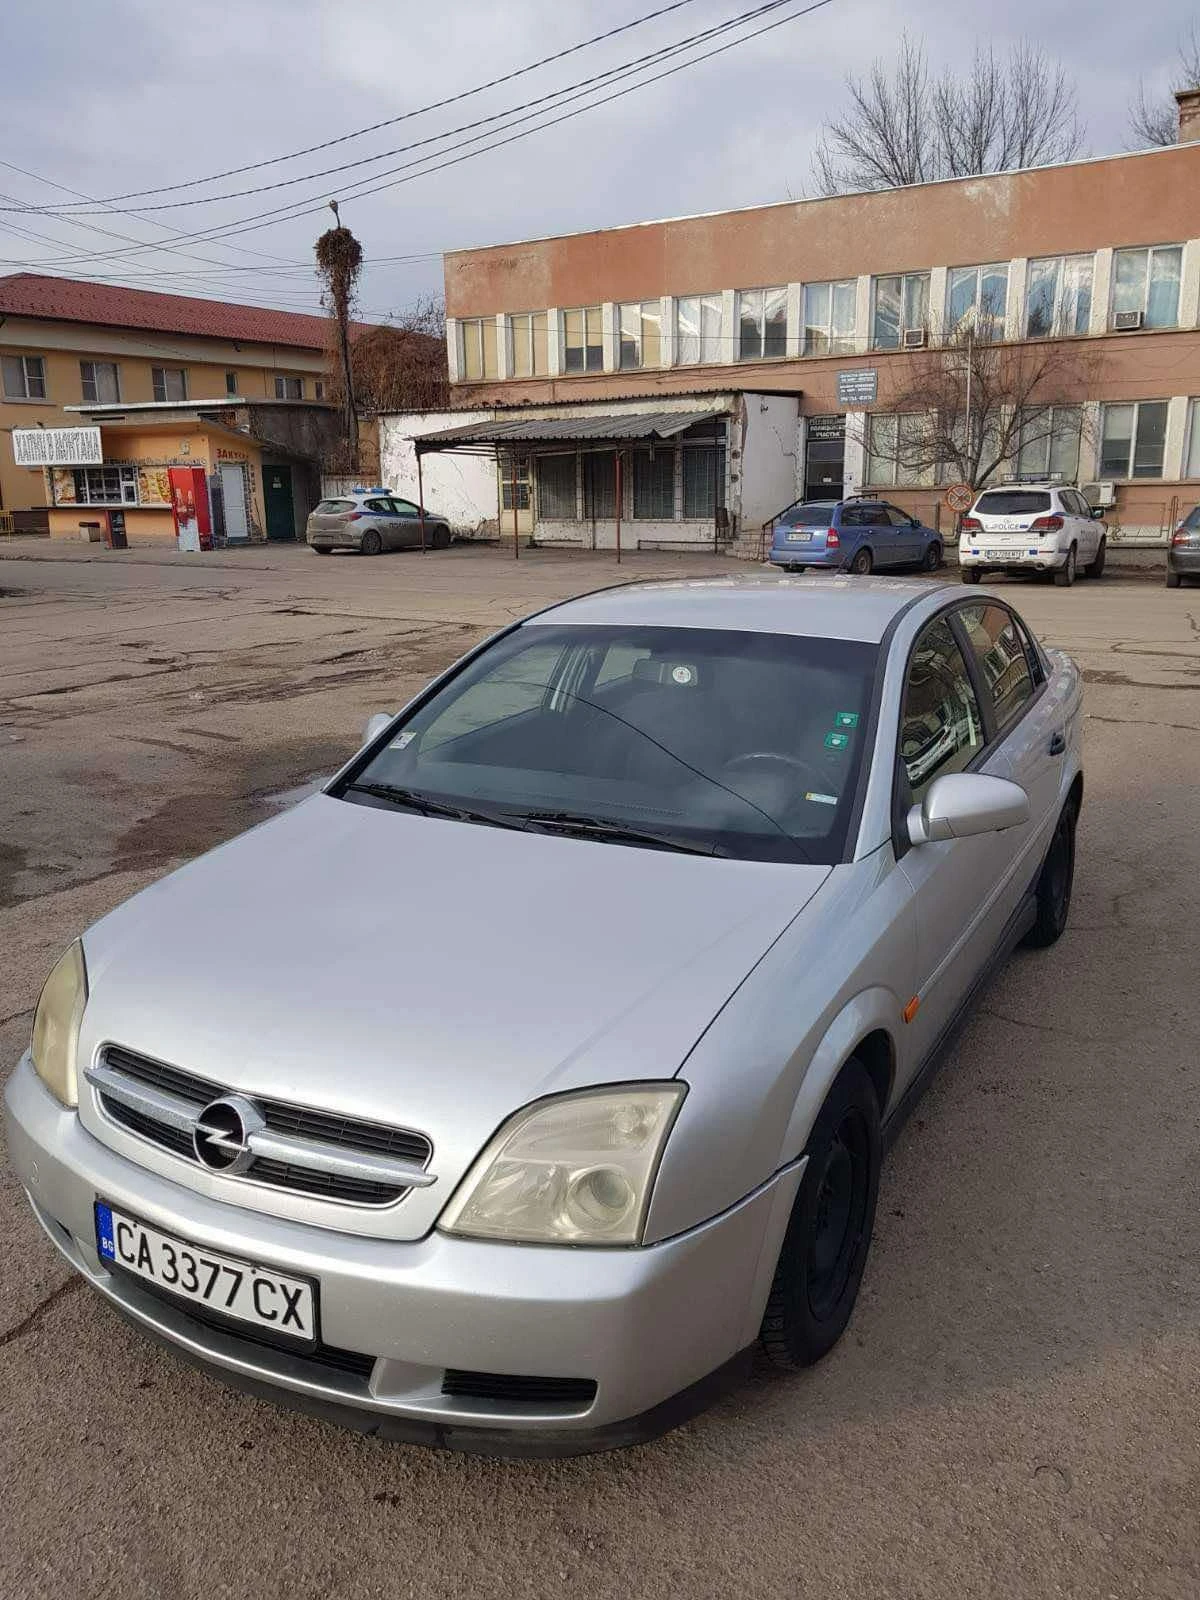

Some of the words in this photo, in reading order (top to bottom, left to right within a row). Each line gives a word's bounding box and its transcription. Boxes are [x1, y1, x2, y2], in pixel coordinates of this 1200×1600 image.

[102, 1237, 114, 1252] BG
[117, 1222, 154, 1278] CA
[161, 1243, 243, 1307] 3377
[252, 1278, 305, 1330] CX
